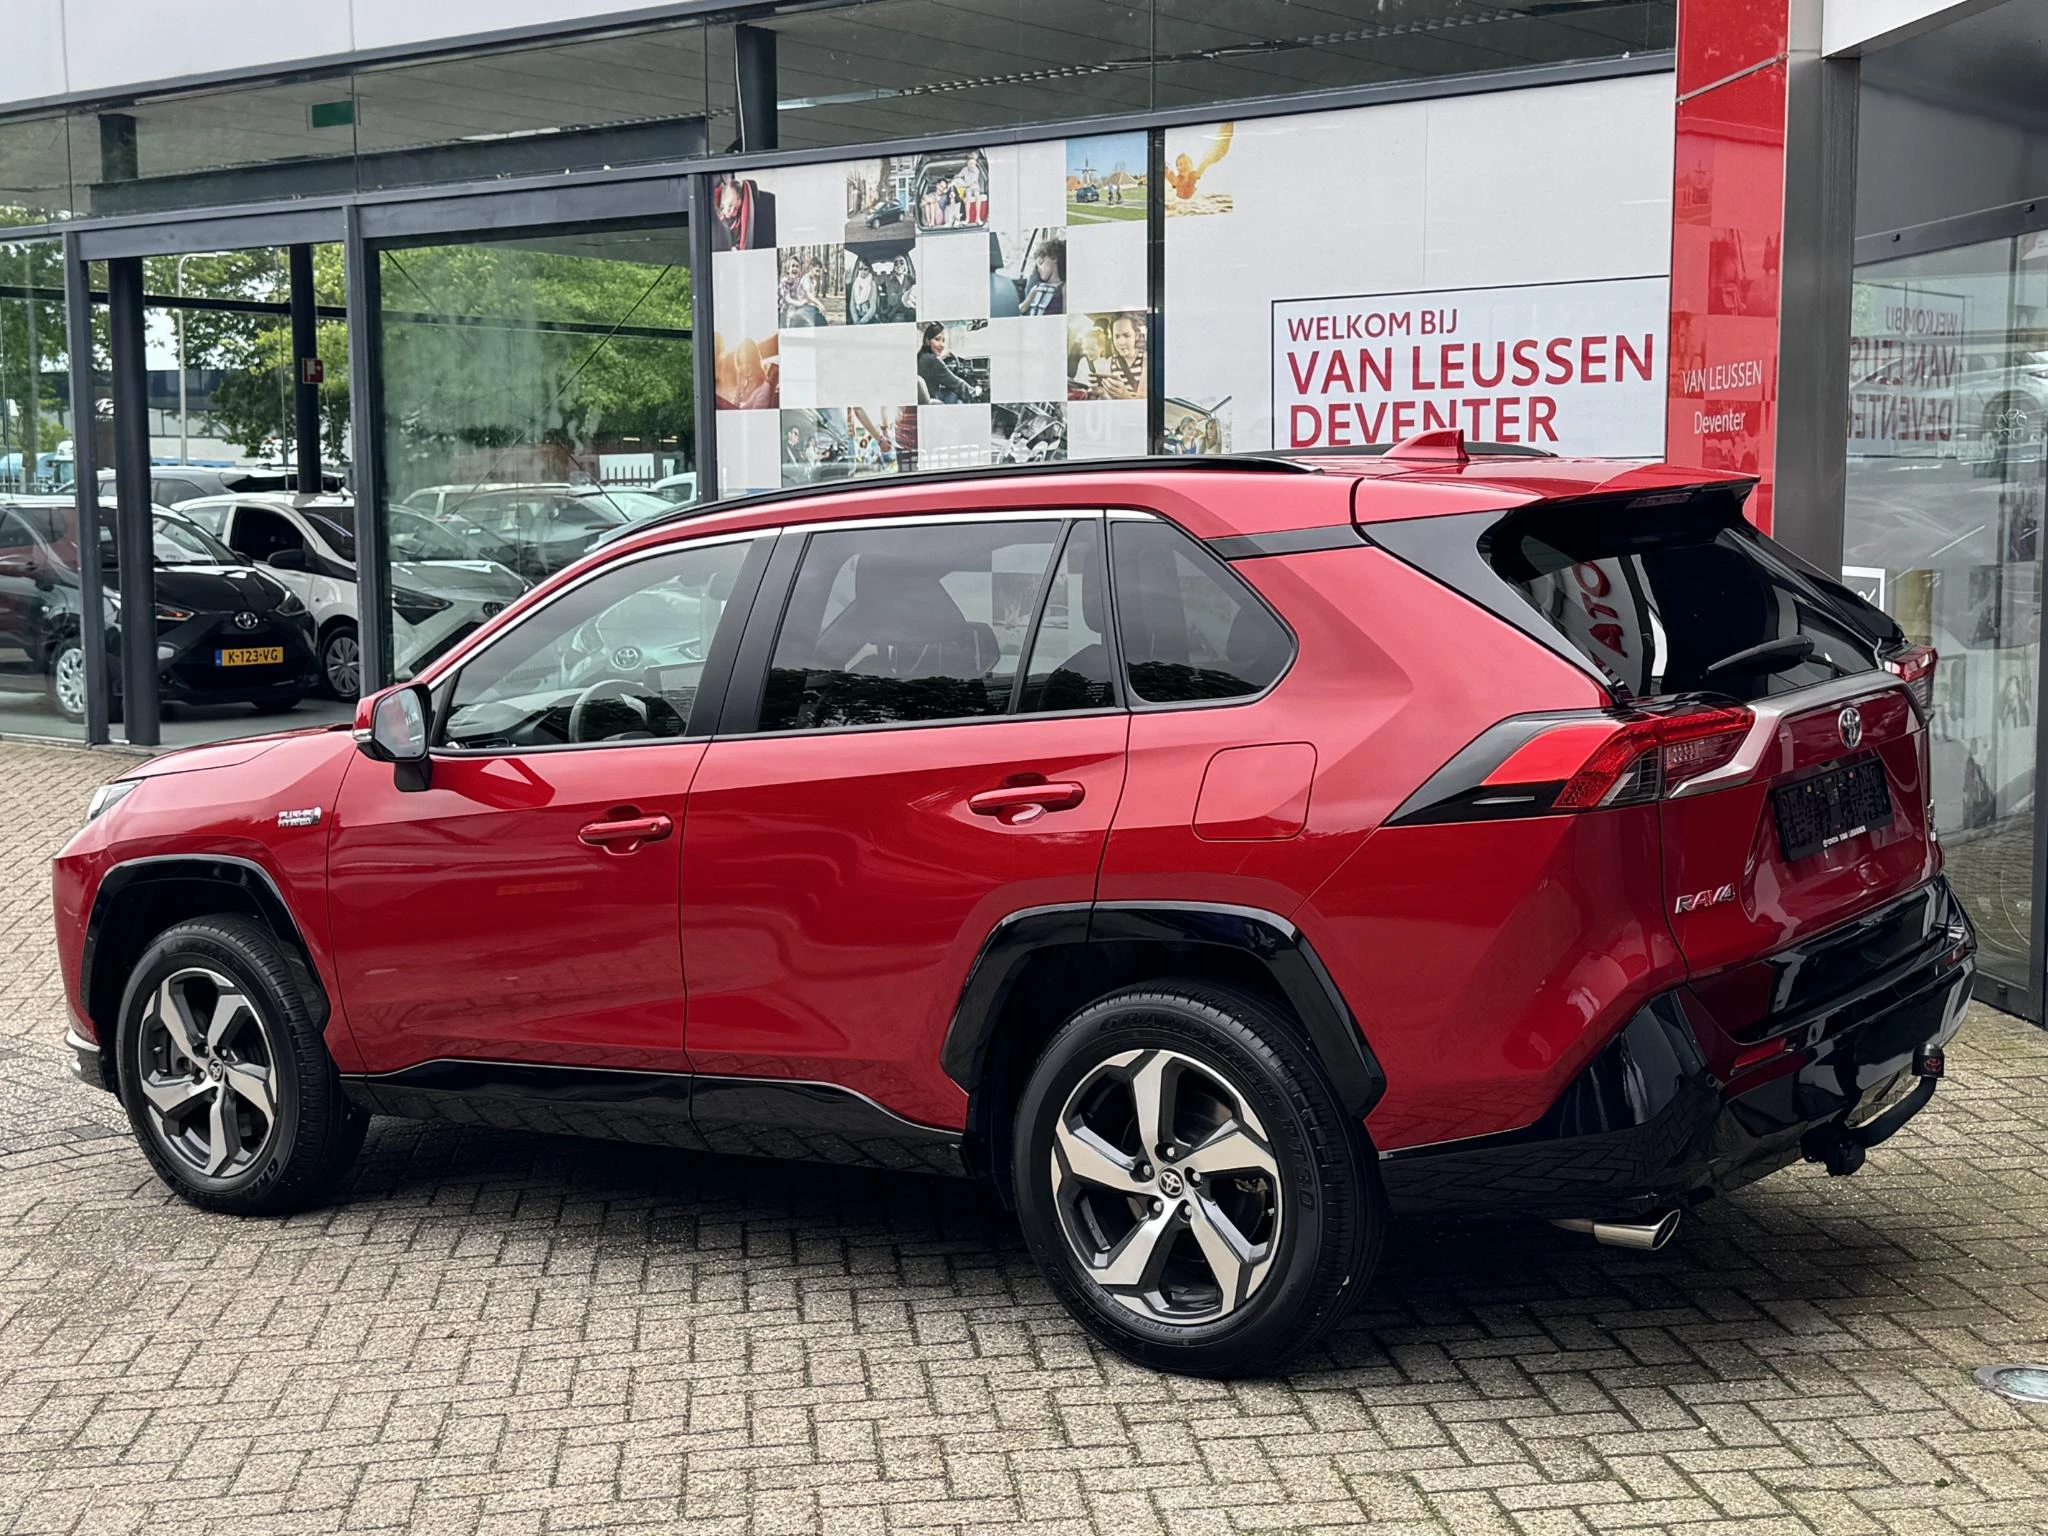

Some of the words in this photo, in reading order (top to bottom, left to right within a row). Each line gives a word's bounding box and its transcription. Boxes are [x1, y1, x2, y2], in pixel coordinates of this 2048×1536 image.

[1287, 311, 1411, 342] WELKOM
[1420, 308, 1458, 335] BIJ
[1287, 347, 1393, 395] VAN
[1411, 332, 1654, 391] LEUSSEN
[1682, 368, 1707, 394] VAN
[1709, 359, 1763, 392] LEUSSEN
[1290, 395, 1560, 448] DEVENTER
[1694, 408, 1747, 435] Deventer
[228, 648, 278, 664] K-123-VG
[1674, 883, 1736, 914] RAV4
